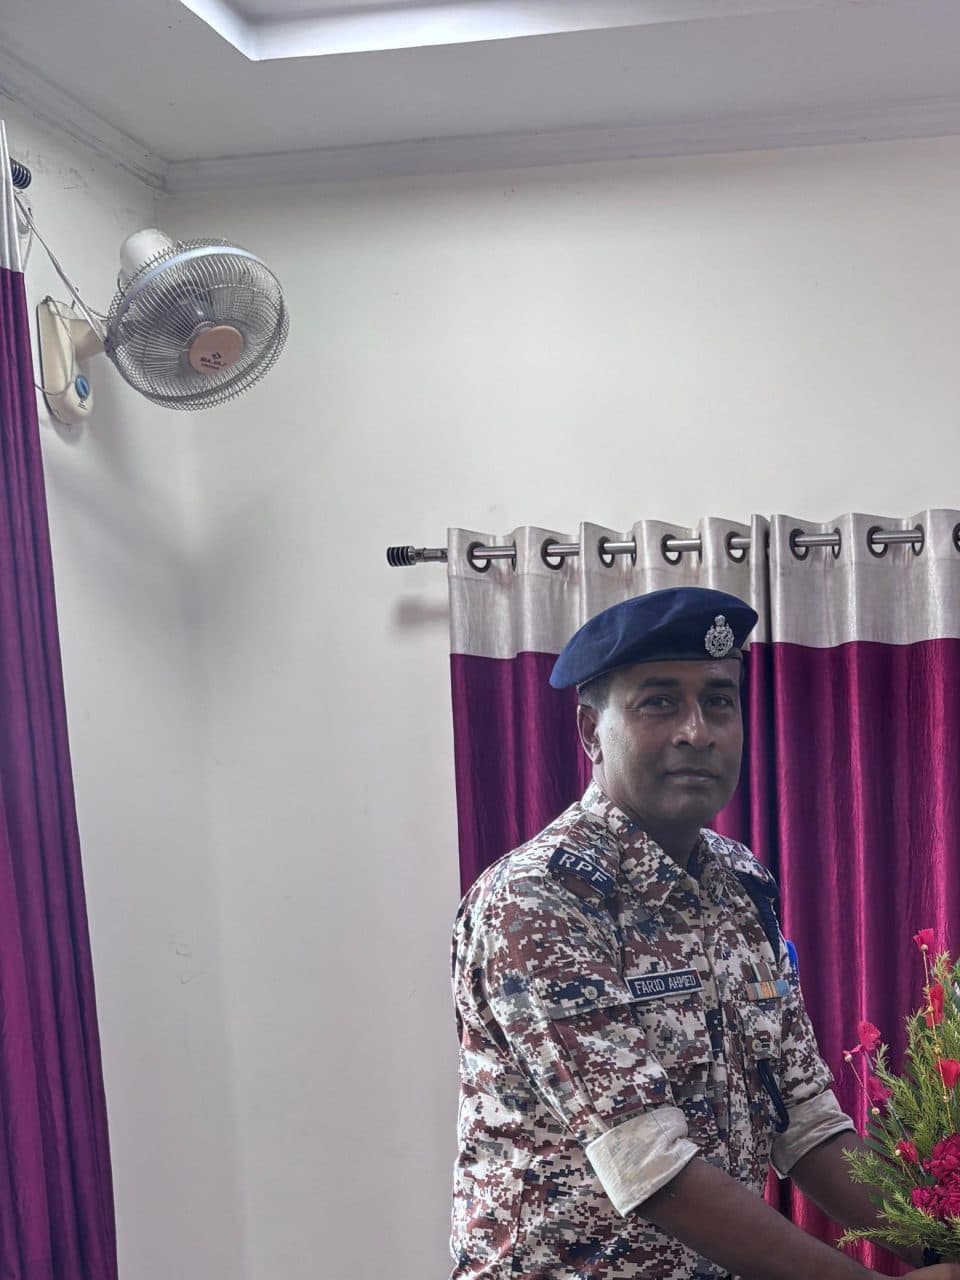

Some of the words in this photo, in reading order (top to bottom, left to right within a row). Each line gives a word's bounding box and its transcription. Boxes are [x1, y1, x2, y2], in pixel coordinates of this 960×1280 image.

[559, 853, 607, 882] RPF
[634, 978, 665, 996] FARID
[668, 974, 696, 990] AHMED
